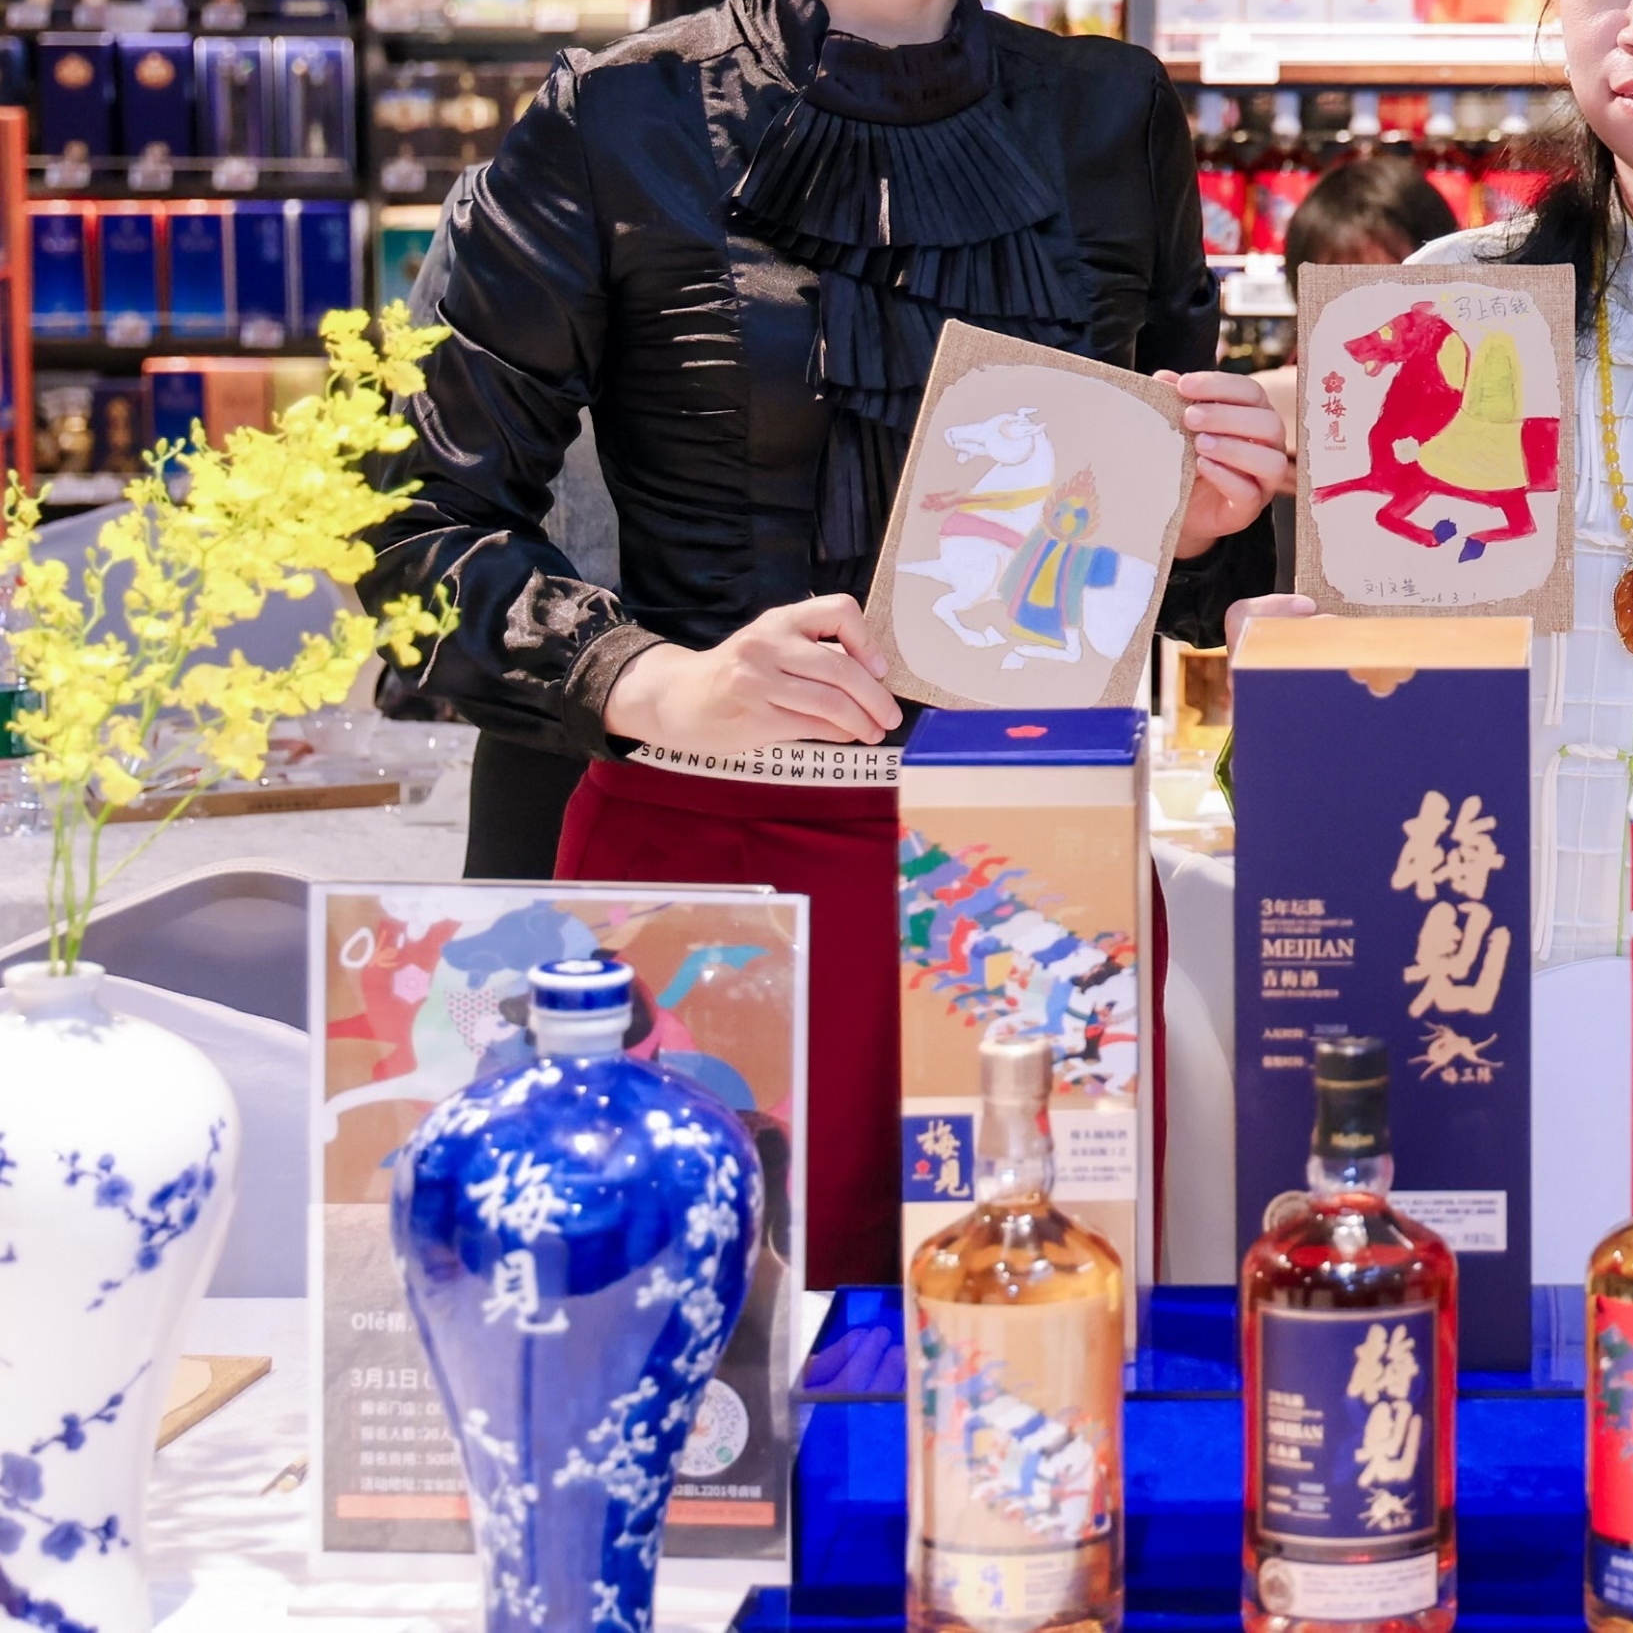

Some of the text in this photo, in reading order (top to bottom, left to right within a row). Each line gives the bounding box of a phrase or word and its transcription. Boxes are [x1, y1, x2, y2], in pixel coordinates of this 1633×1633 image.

[1453, 295, 1530, 321] 马上有钱
[1261, 938, 1356, 959] MEIJIAN
